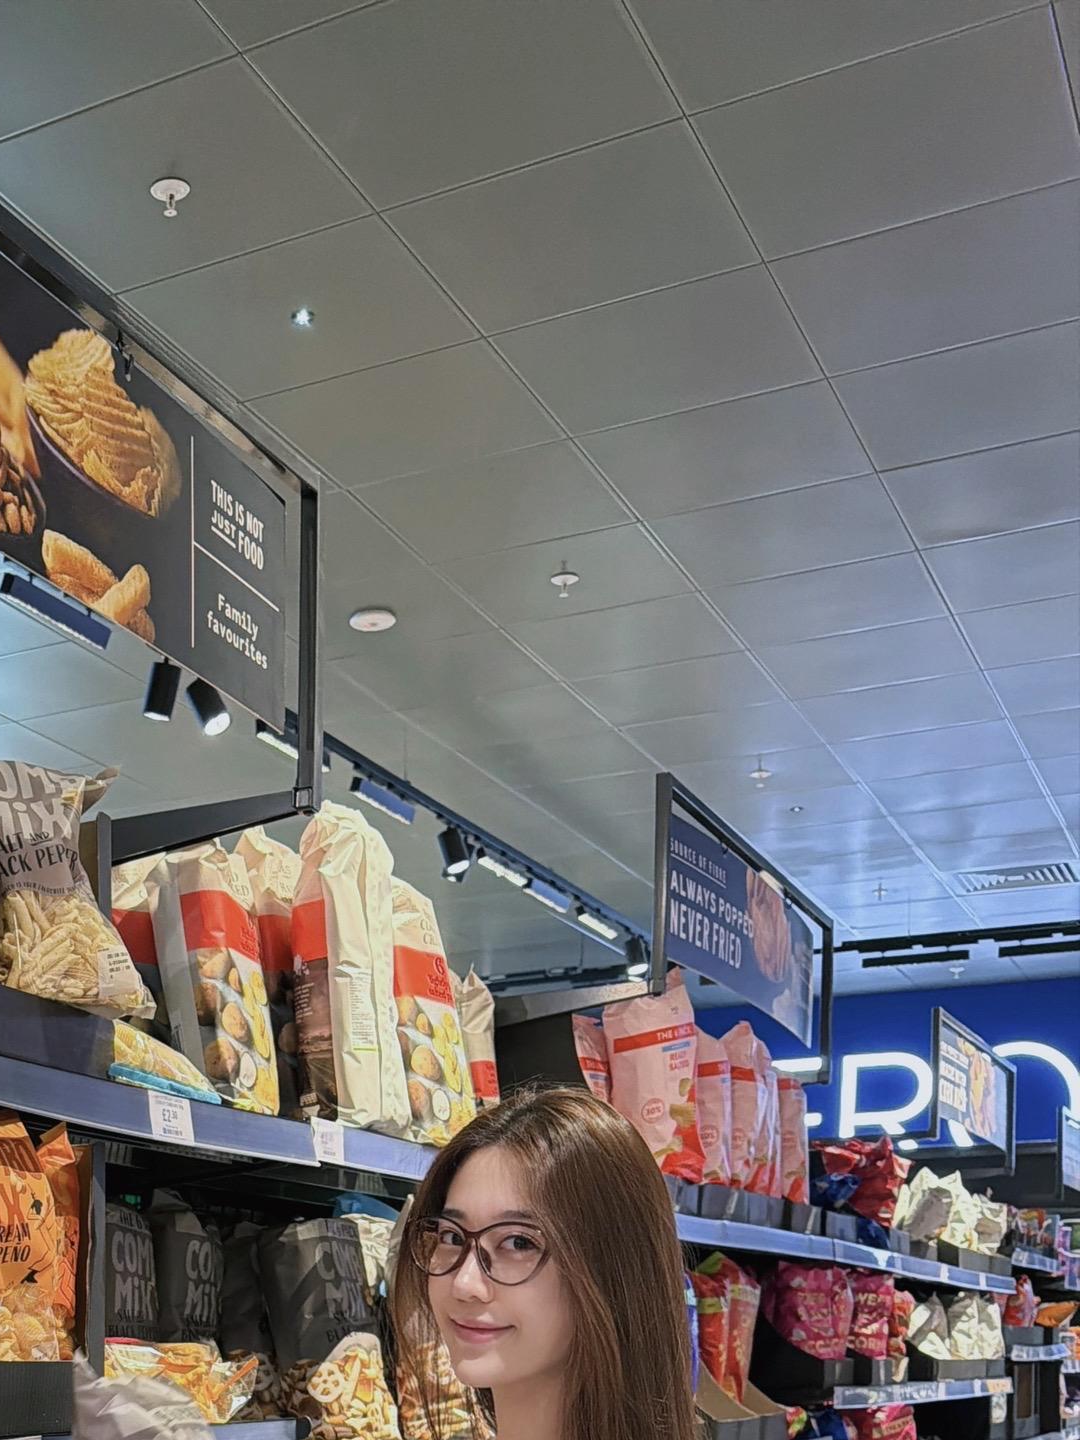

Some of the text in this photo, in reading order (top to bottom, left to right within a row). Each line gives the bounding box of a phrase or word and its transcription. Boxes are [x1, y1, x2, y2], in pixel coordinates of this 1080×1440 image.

[210, 480, 265, 543] THIS IS NOT
[211, 510, 265, 571] JUST FOOD
[206, 611, 268, 671] favourites
[217, 593, 259, 639] Family
[670, 870, 754, 938] ALWAYS POPPED
[670, 898, 742, 969] NEVER FRIED
